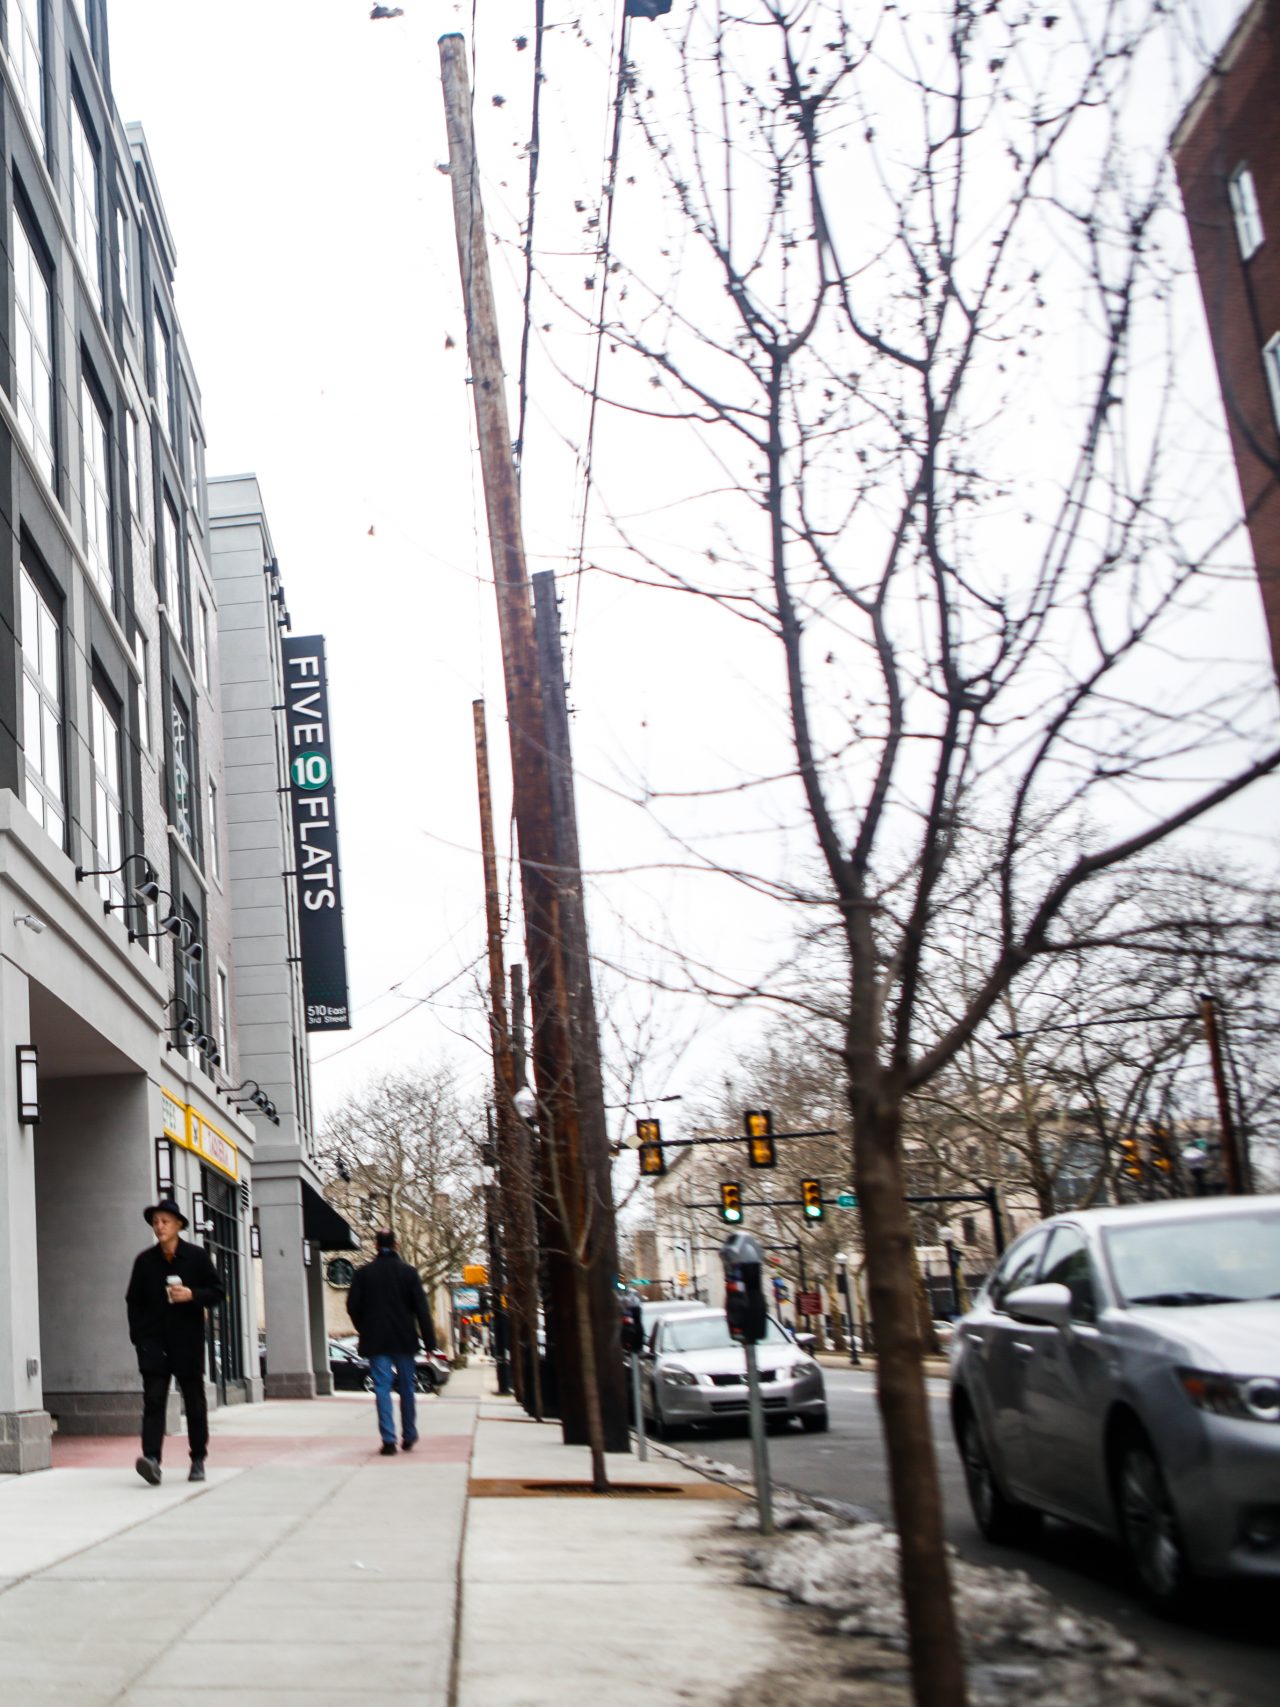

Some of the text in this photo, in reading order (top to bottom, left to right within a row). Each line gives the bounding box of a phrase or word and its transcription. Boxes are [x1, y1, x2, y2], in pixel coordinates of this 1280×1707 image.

[289, 656, 336, 911] FIVE 10 FLATS
[307, 1005, 346, 1016] 510 East
